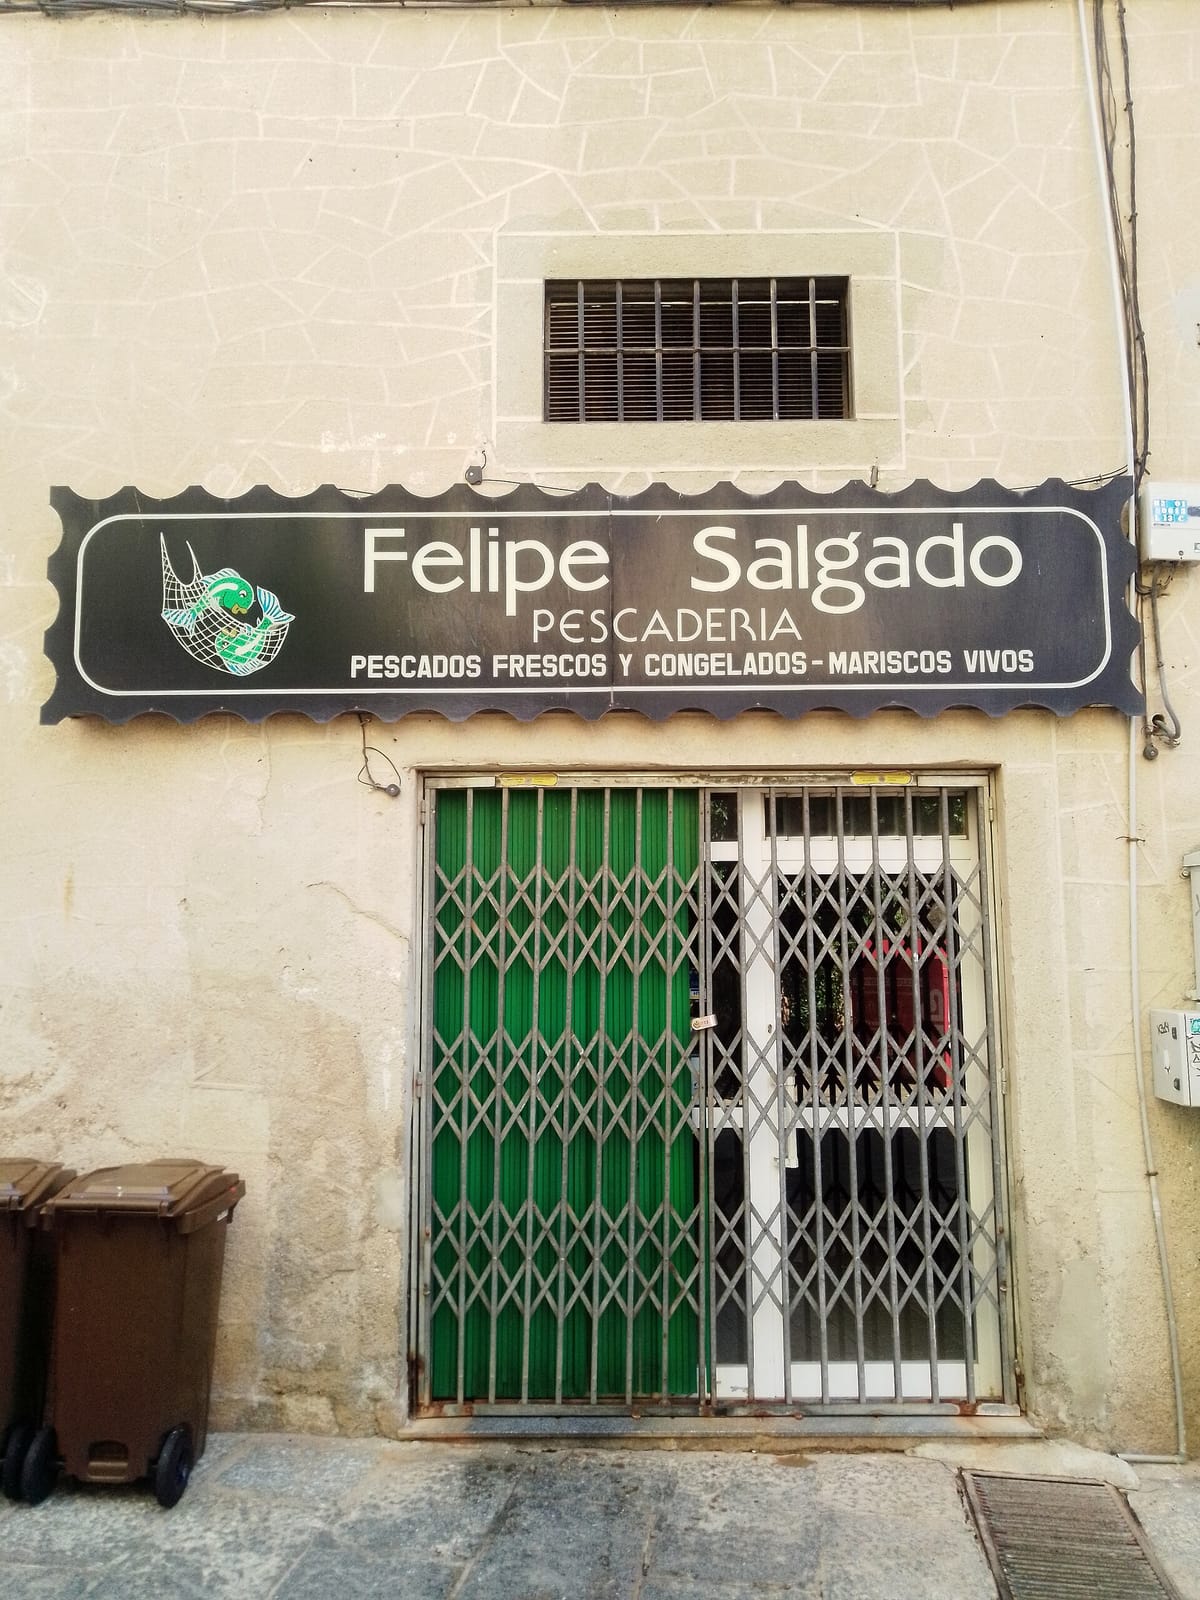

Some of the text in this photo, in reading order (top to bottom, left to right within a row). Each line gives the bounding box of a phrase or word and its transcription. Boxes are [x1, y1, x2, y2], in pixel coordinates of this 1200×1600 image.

[364, 523, 1023, 617] Felipe Salgado
[533, 608, 803, 643] PESCADERIA
[351, 655, 482, 679] PESCADOS
[493, 654, 607, 678] FRESCOS
[619, 654, 633, 678] Y
[645, 652, 808, 677] CONGELADOS
[829, 651, 952, 675] MARISCOS
[964, 650, 1034, 673] VIVOS
